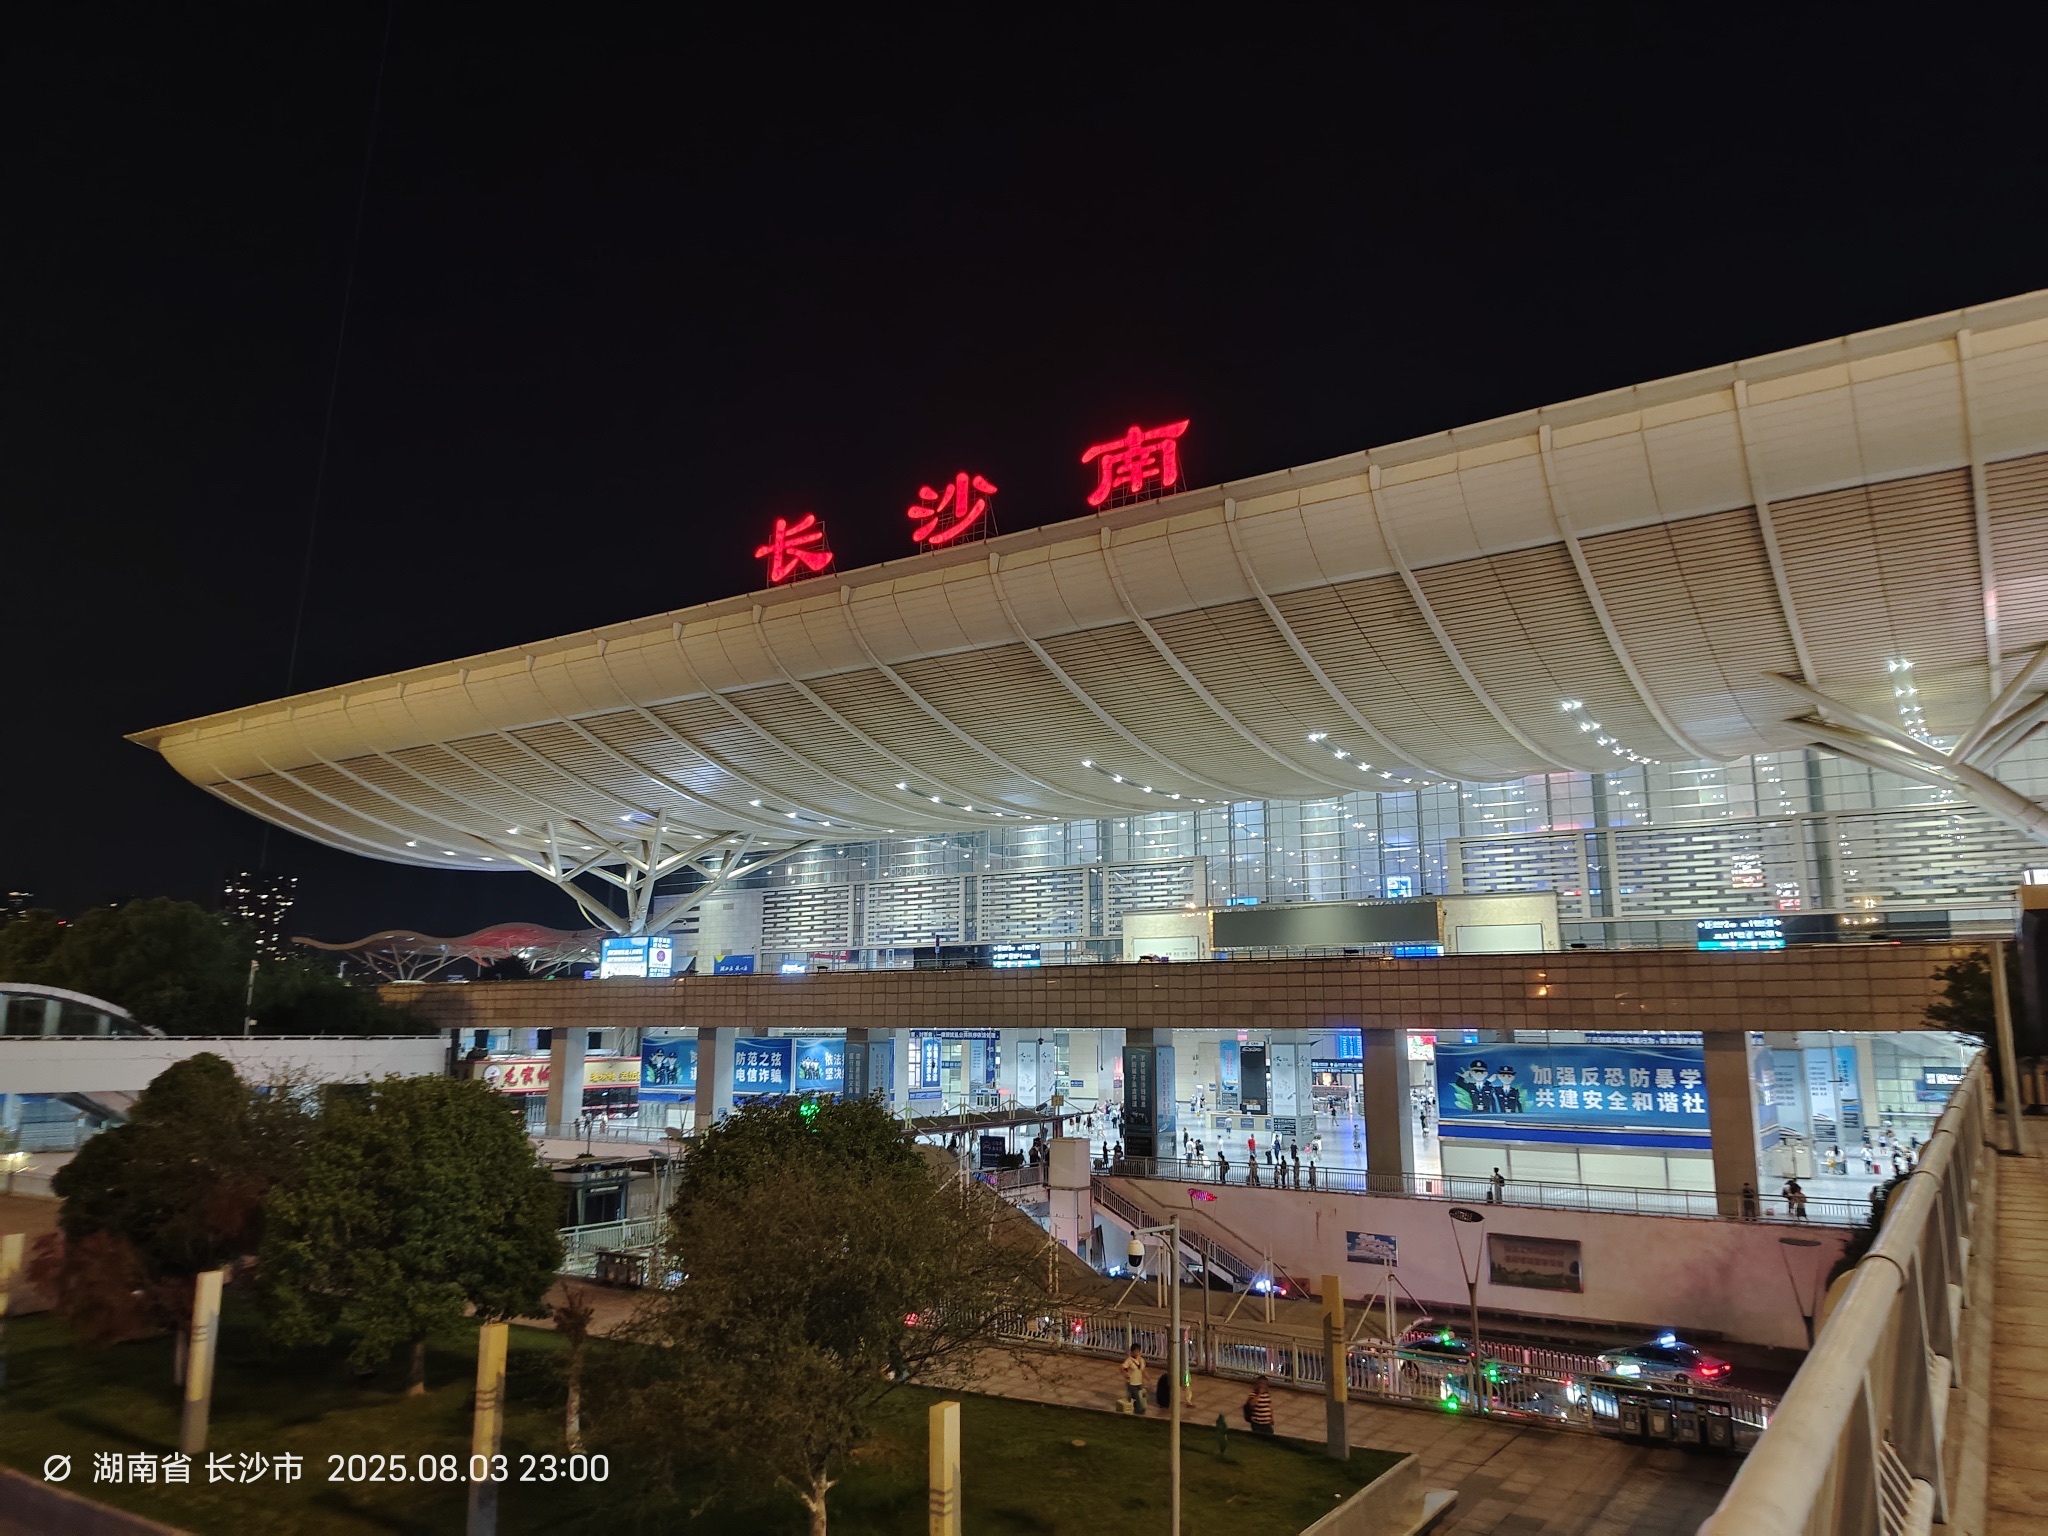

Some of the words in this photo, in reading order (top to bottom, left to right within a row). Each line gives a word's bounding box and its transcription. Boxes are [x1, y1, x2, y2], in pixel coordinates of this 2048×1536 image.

[756, 420, 1189, 581] 长沙南
[735, 1051, 782, 1067] 防范之弦
[825, 1051, 844, 1066] 依法
[735, 1067, 782, 1083] 电信诈骗
[825, 1067, 844, 1080] 坚决
[1533, 1066, 1702, 1089] 加强反恐防暴学
[1535, 1088, 1706, 1113] 共建安全和谐社
